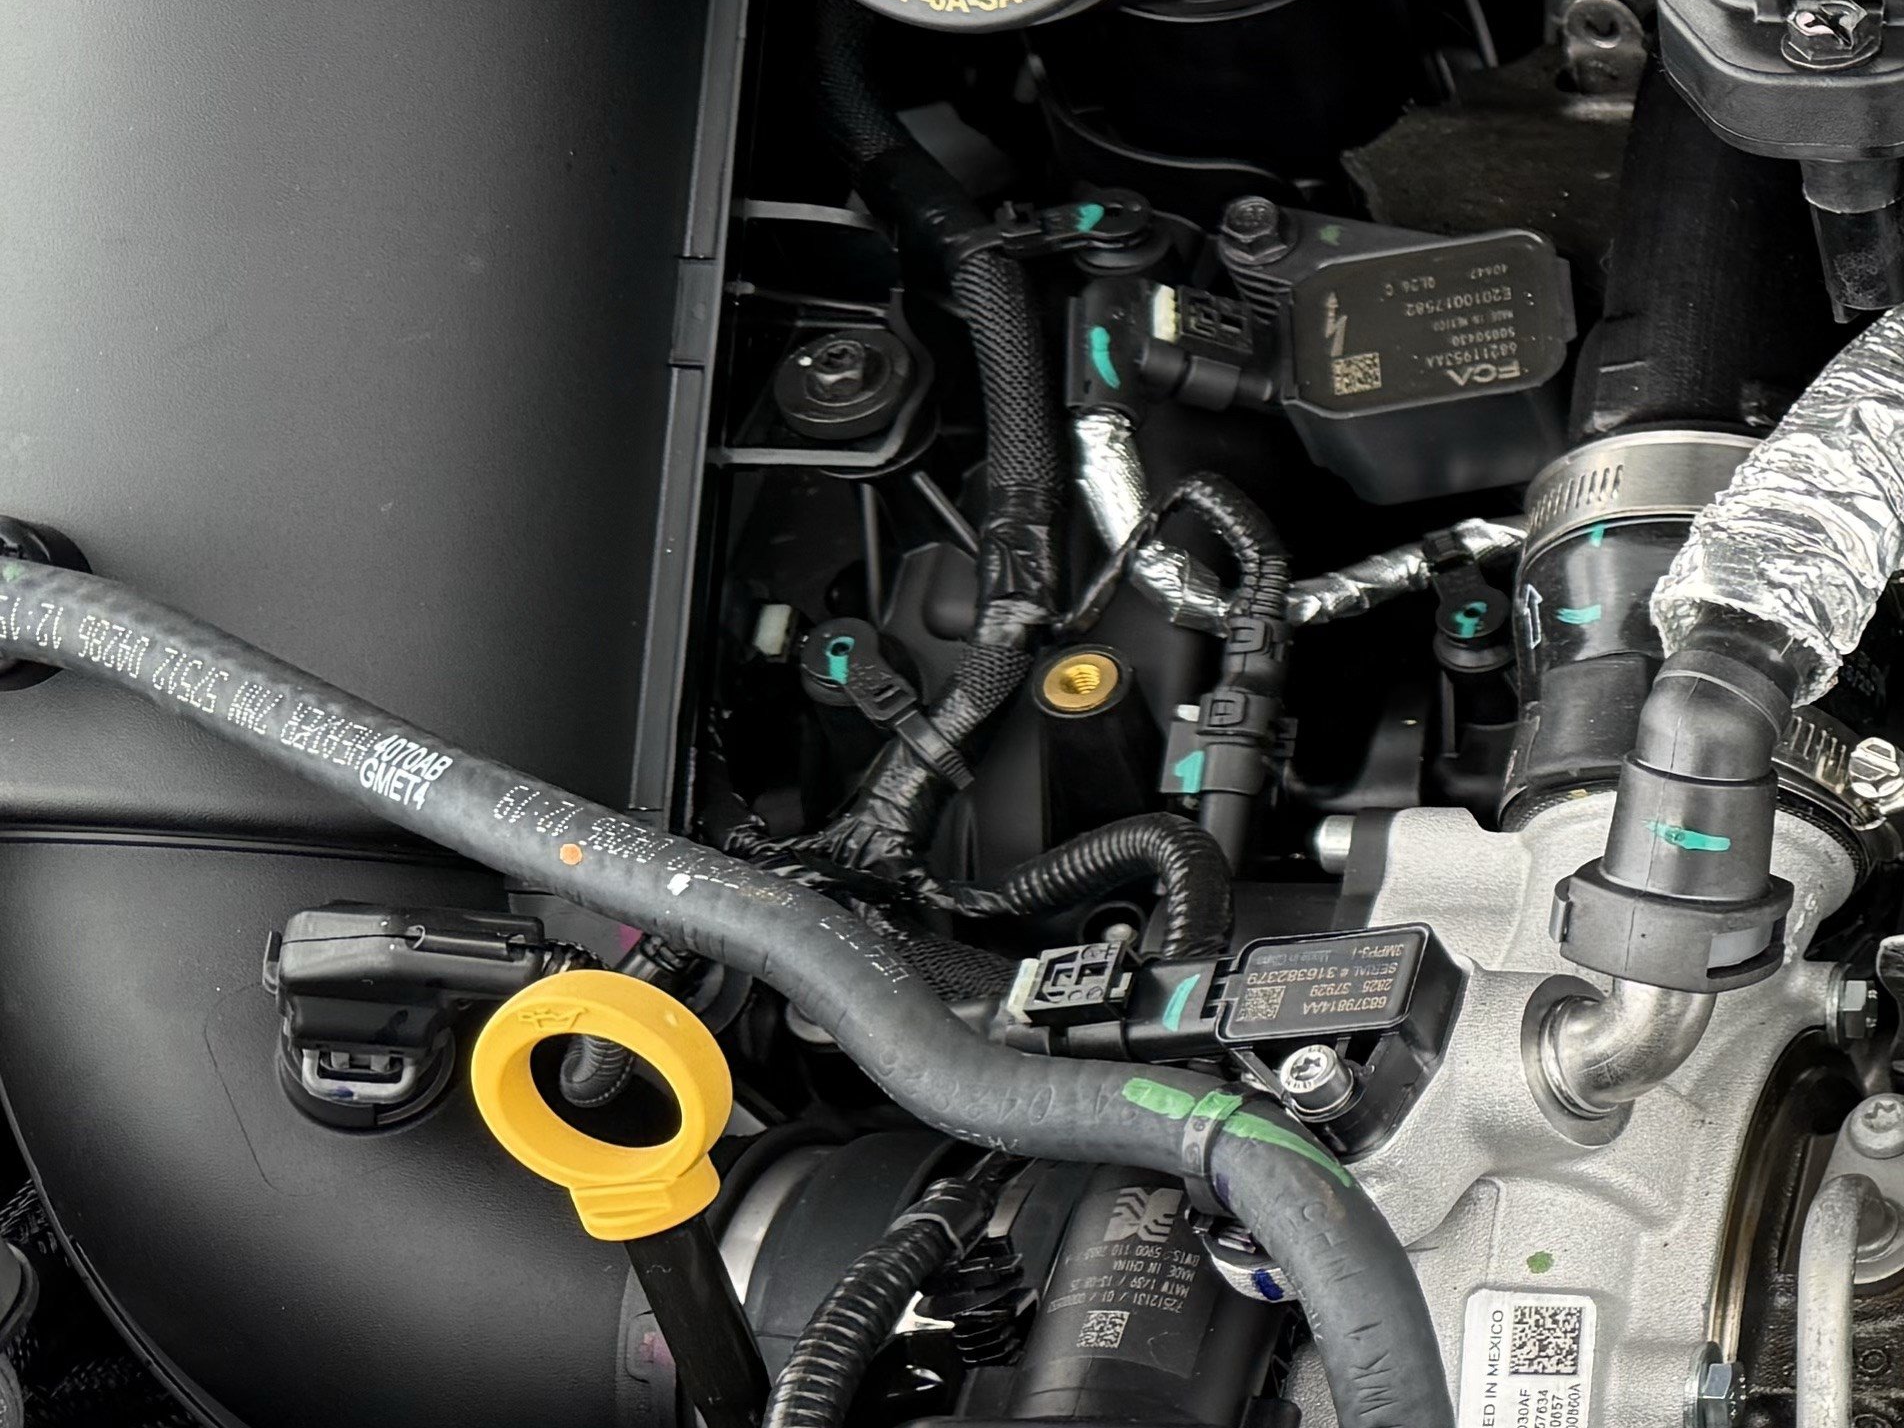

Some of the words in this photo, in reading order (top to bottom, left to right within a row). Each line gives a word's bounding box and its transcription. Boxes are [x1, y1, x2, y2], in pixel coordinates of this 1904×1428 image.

[1445, 359, 1521, 387] FCA
[373, 733, 453, 782] 4070AB
[358, 757, 430, 810] GMET4
[1246, 966, 1337, 983] 316382379
[1354, 961, 1397, 975] SERIAL
[1309, 982, 1351, 996] 37929
[1302, 996, 1386, 1014] 68379814AA
[1112, 1258, 1143, 1274] CHINA
[1148, 1262, 1160, 1276] IN
[1167, 1264, 1194, 1281] MADE
[1487, 1309, 1503, 1376] MEXICO
[1485, 1382, 1497, 1398] IN
